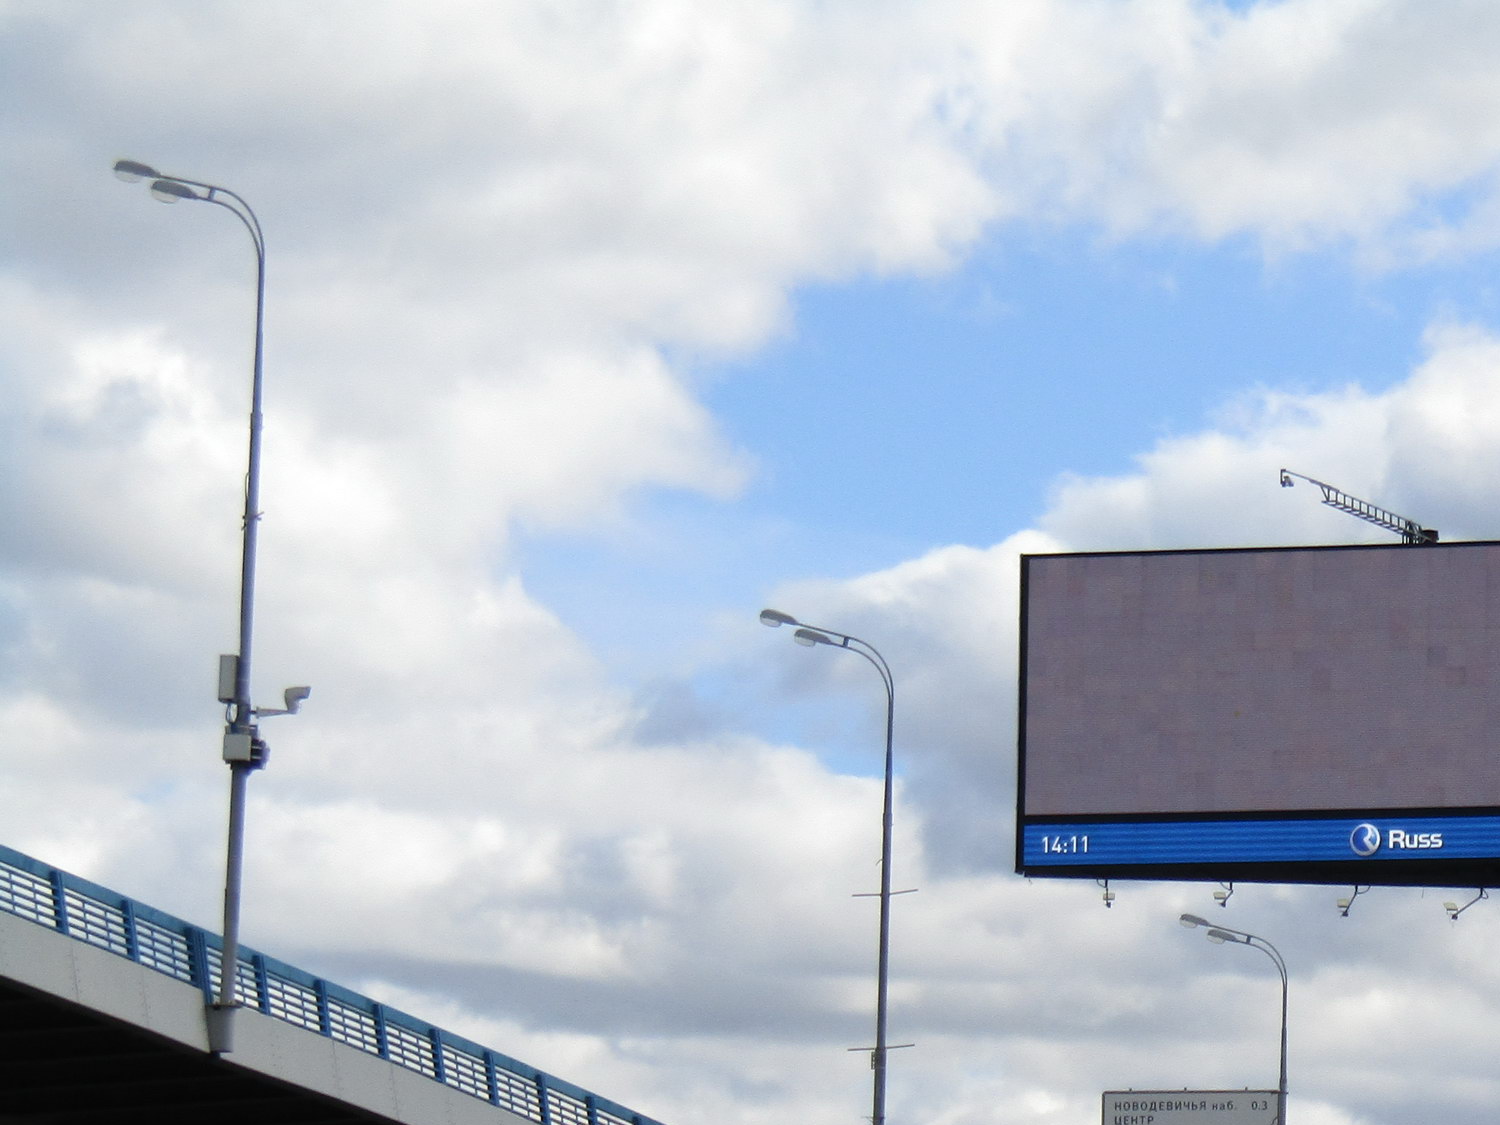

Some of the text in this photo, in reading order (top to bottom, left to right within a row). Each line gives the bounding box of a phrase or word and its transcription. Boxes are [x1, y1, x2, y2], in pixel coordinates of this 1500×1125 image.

[1042, 835, 1089, 854] 14:11
[1388, 829, 1443, 849] Russ
[1114, 1101, 1206, 1112] НОВОДЕВИЧЬЯ
[1212, 1101, 1237, 1111] наб.
[1114, 1116, 1153, 1125] ЦЕНТР
